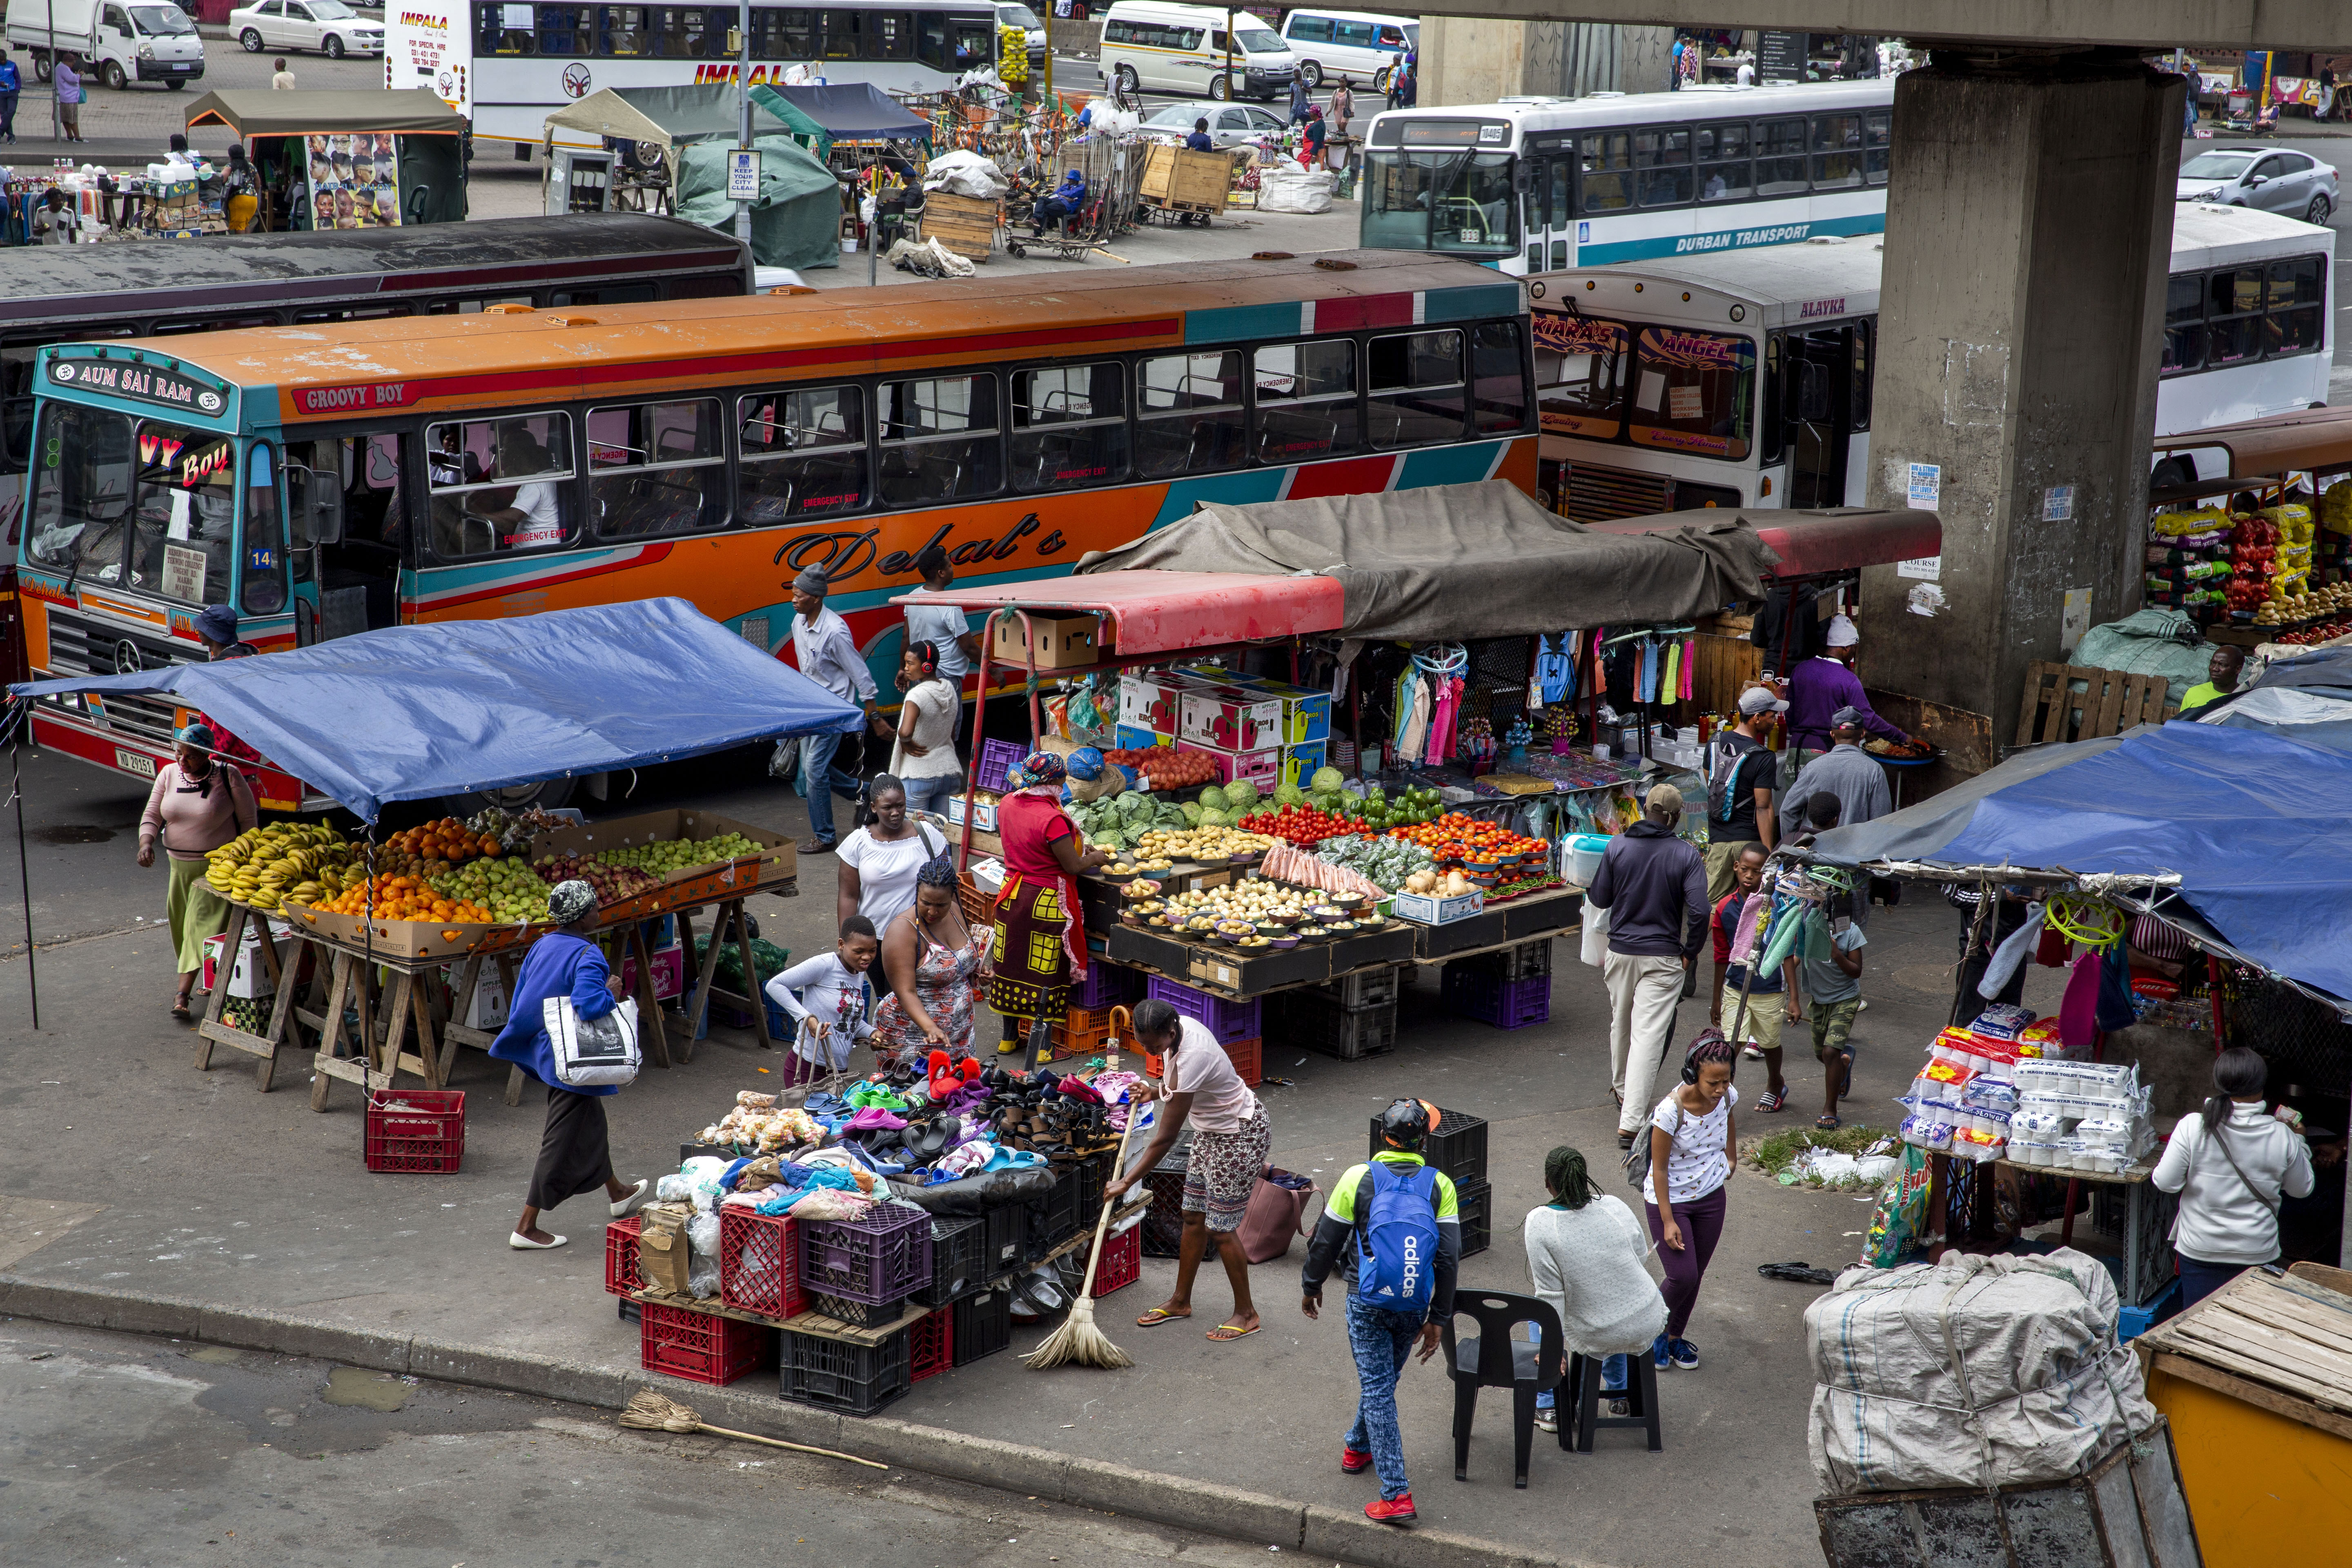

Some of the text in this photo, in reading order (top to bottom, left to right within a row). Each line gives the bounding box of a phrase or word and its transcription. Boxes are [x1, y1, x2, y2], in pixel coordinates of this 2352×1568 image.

[400, 11, 448, 30] IMPALA
[419, 41, 434, 49] SPECIAL
[314, 183, 339, 191] HAIR
[360, 183, 392, 191] SALON
[1676, 225, 1811, 252] DURBAN TRANSPORT
[1800, 297, 1845, 318] ALAYKA
[1532, 317, 1613, 343] KIARA'S
[1659, 335, 1731, 361] ANGEL
[79, 366, 117, 387] AUM
[155, 377, 192, 402] RAM
[306, 384, 404, 410] GROOVY BOY
[1285, 439, 1331, 451] EMERGENCY EXIT
[1650, 430, 1729, 450] Every Minute
[140, 434, 185, 471] VY
[183, 443, 228, 487] Boy
[1056, 467, 1107, 479] EMERGENCY EXIT
[2054, 486, 2072, 498] ABORTION
[803, 493, 859, 508] EMERGENCY EXIT
[2051, 507, 2059, 519] 818
[2059, 506, 2070, 518] 9768
[504, 528, 567, 544] EMERGENCY EXIT
[168, 548, 203, 562] RESERVOIR HILLS
[253, 551, 270, 566] 14
[167, 557, 203, 571] TEKWINI COLLEDGE
[173, 566, 189, 575] UMGENI
[177, 575, 193, 586] MAKRO
[175, 584, 194, 595] MARKET
[175, 614, 192, 633] AUM
[1122, 685, 1138, 694] apples
[1183, 699, 1199, 709] apples
[1313, 699, 1330, 710] apples
[1262, 706, 1280, 716] apples
[1121, 712, 1157, 725] eros EROS
[1117, 729, 1134, 739] apples
[1183, 727, 1220, 740] eros EROS
[1258, 724, 1270, 733] eros
[1307, 746, 1325, 757] apples
[120, 752, 151, 773] ND 29151
[483, 1013, 507, 1026] eros
[1402, 1235, 1420, 1298] adidas
